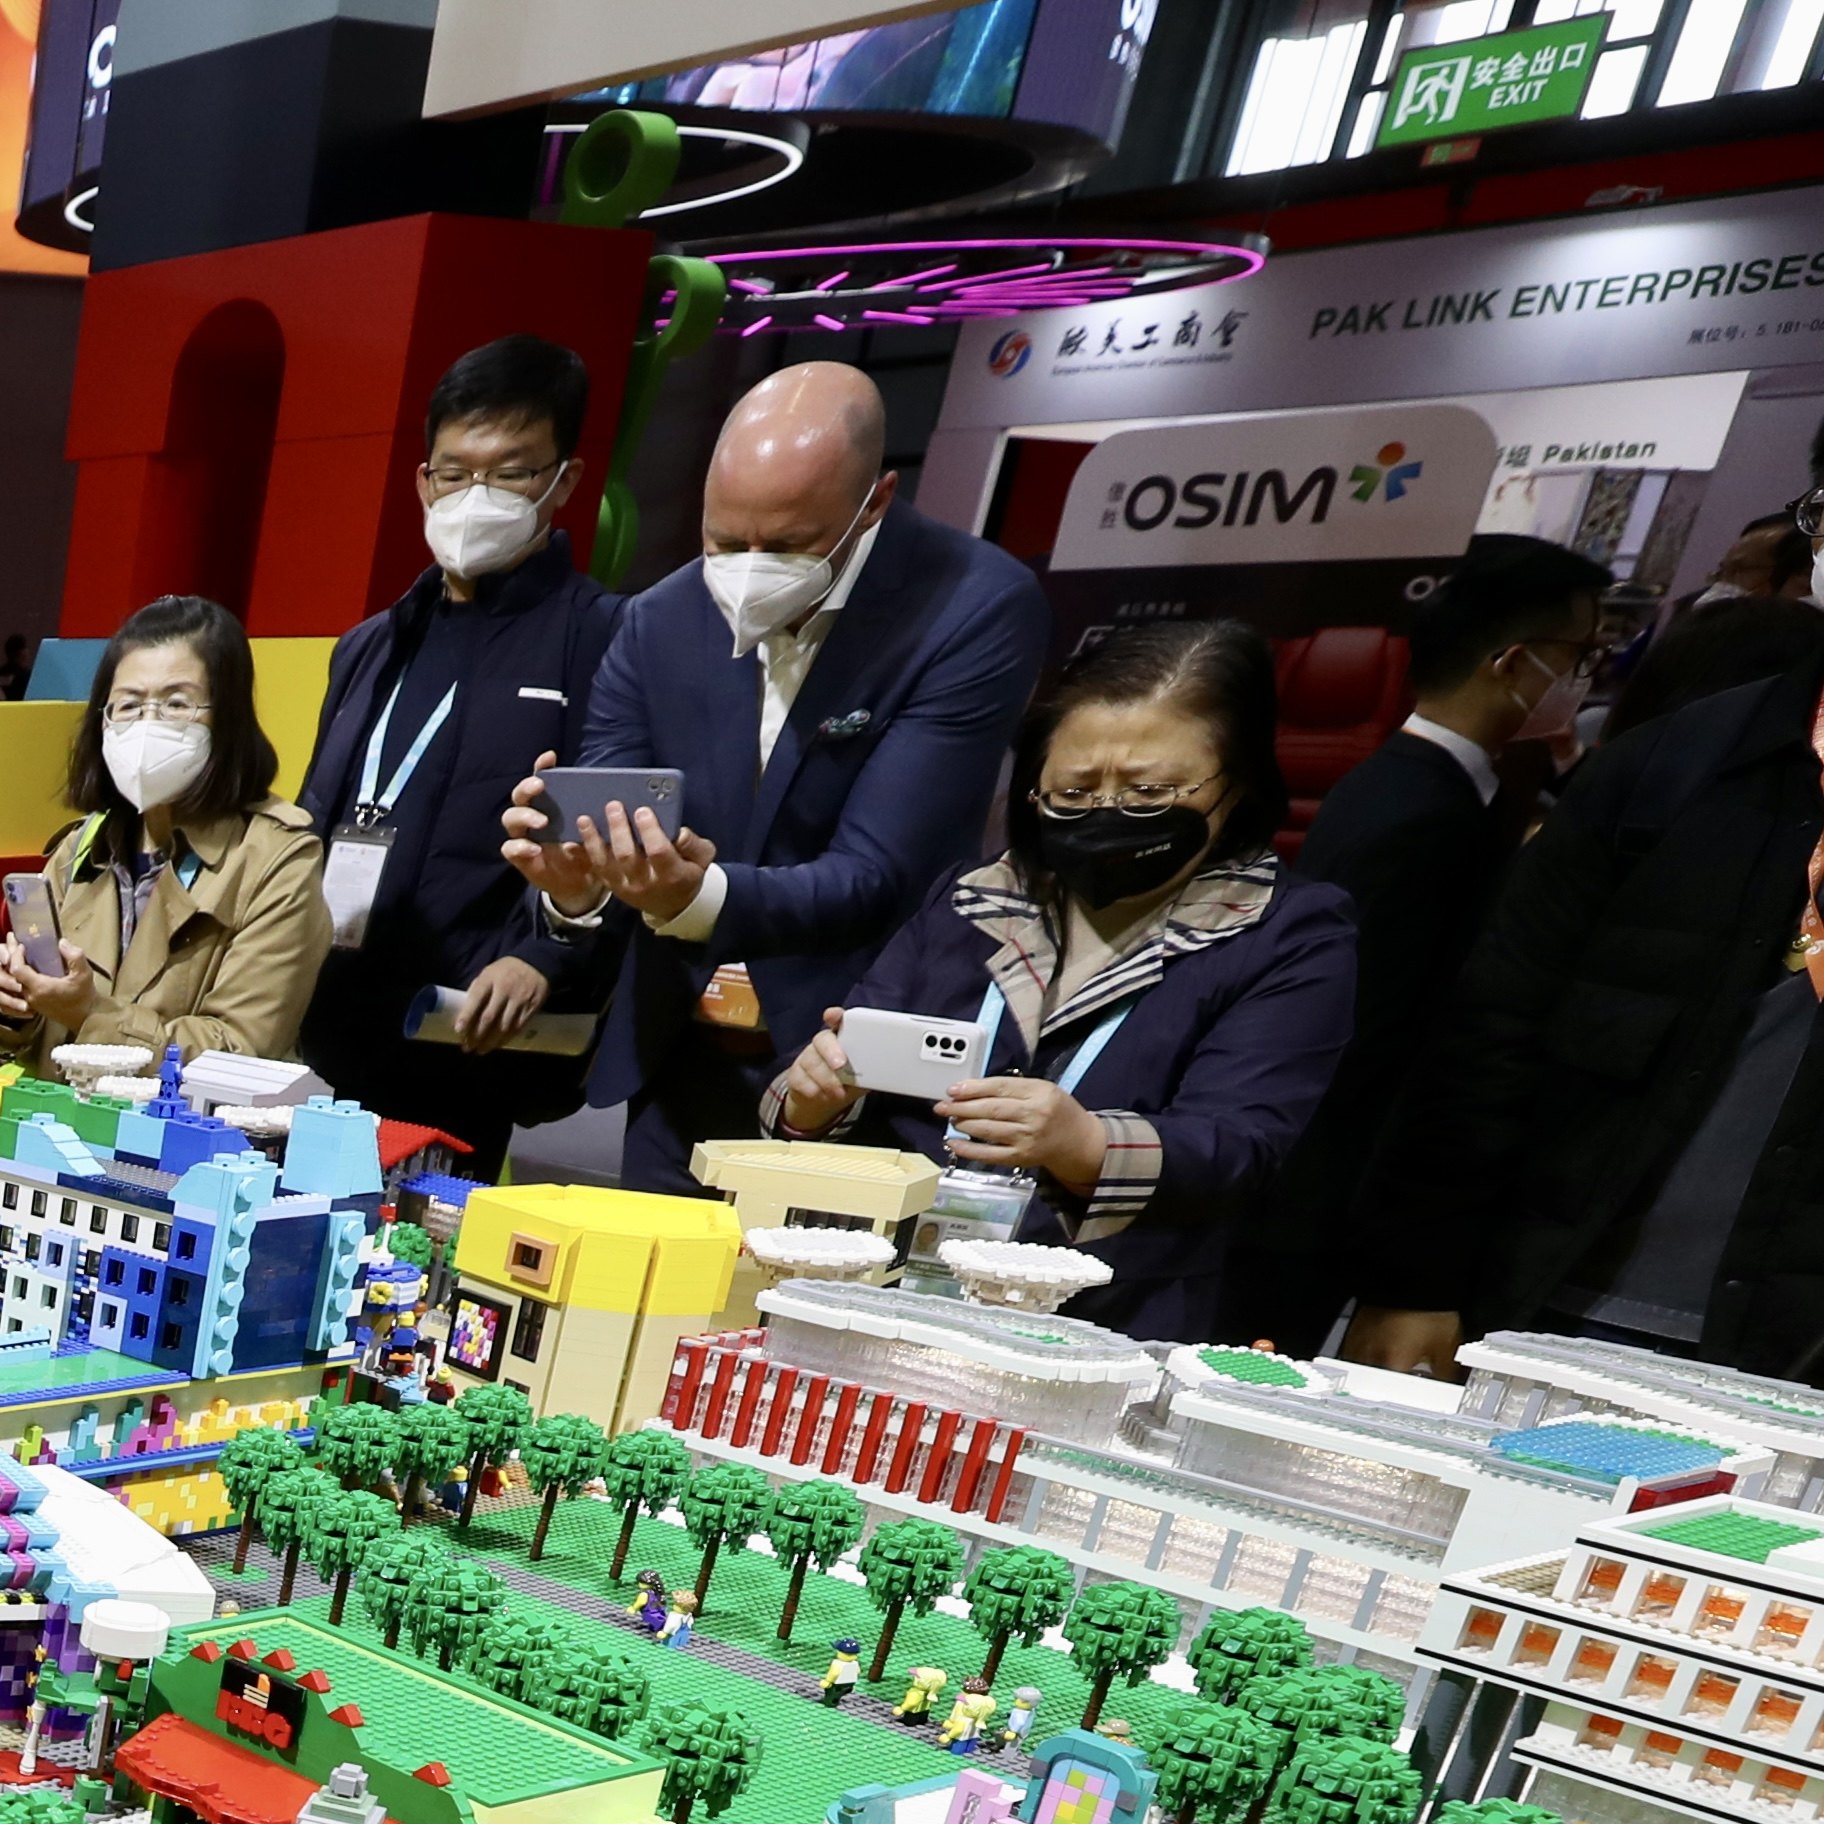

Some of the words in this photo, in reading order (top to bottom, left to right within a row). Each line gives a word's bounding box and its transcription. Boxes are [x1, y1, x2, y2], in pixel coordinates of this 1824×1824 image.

[1470, 42, 1588, 90] 安全出口
[1487, 78, 1549, 110] EXIT
[1309, 301, 1393, 340] PAK
[1401, 287, 1501, 331] LINK
[1508, 251, 1824, 319] ENTERPRISES
[1543, 440, 1657, 465] Pakistan
[1124, 464, 1339, 532] OSIM
